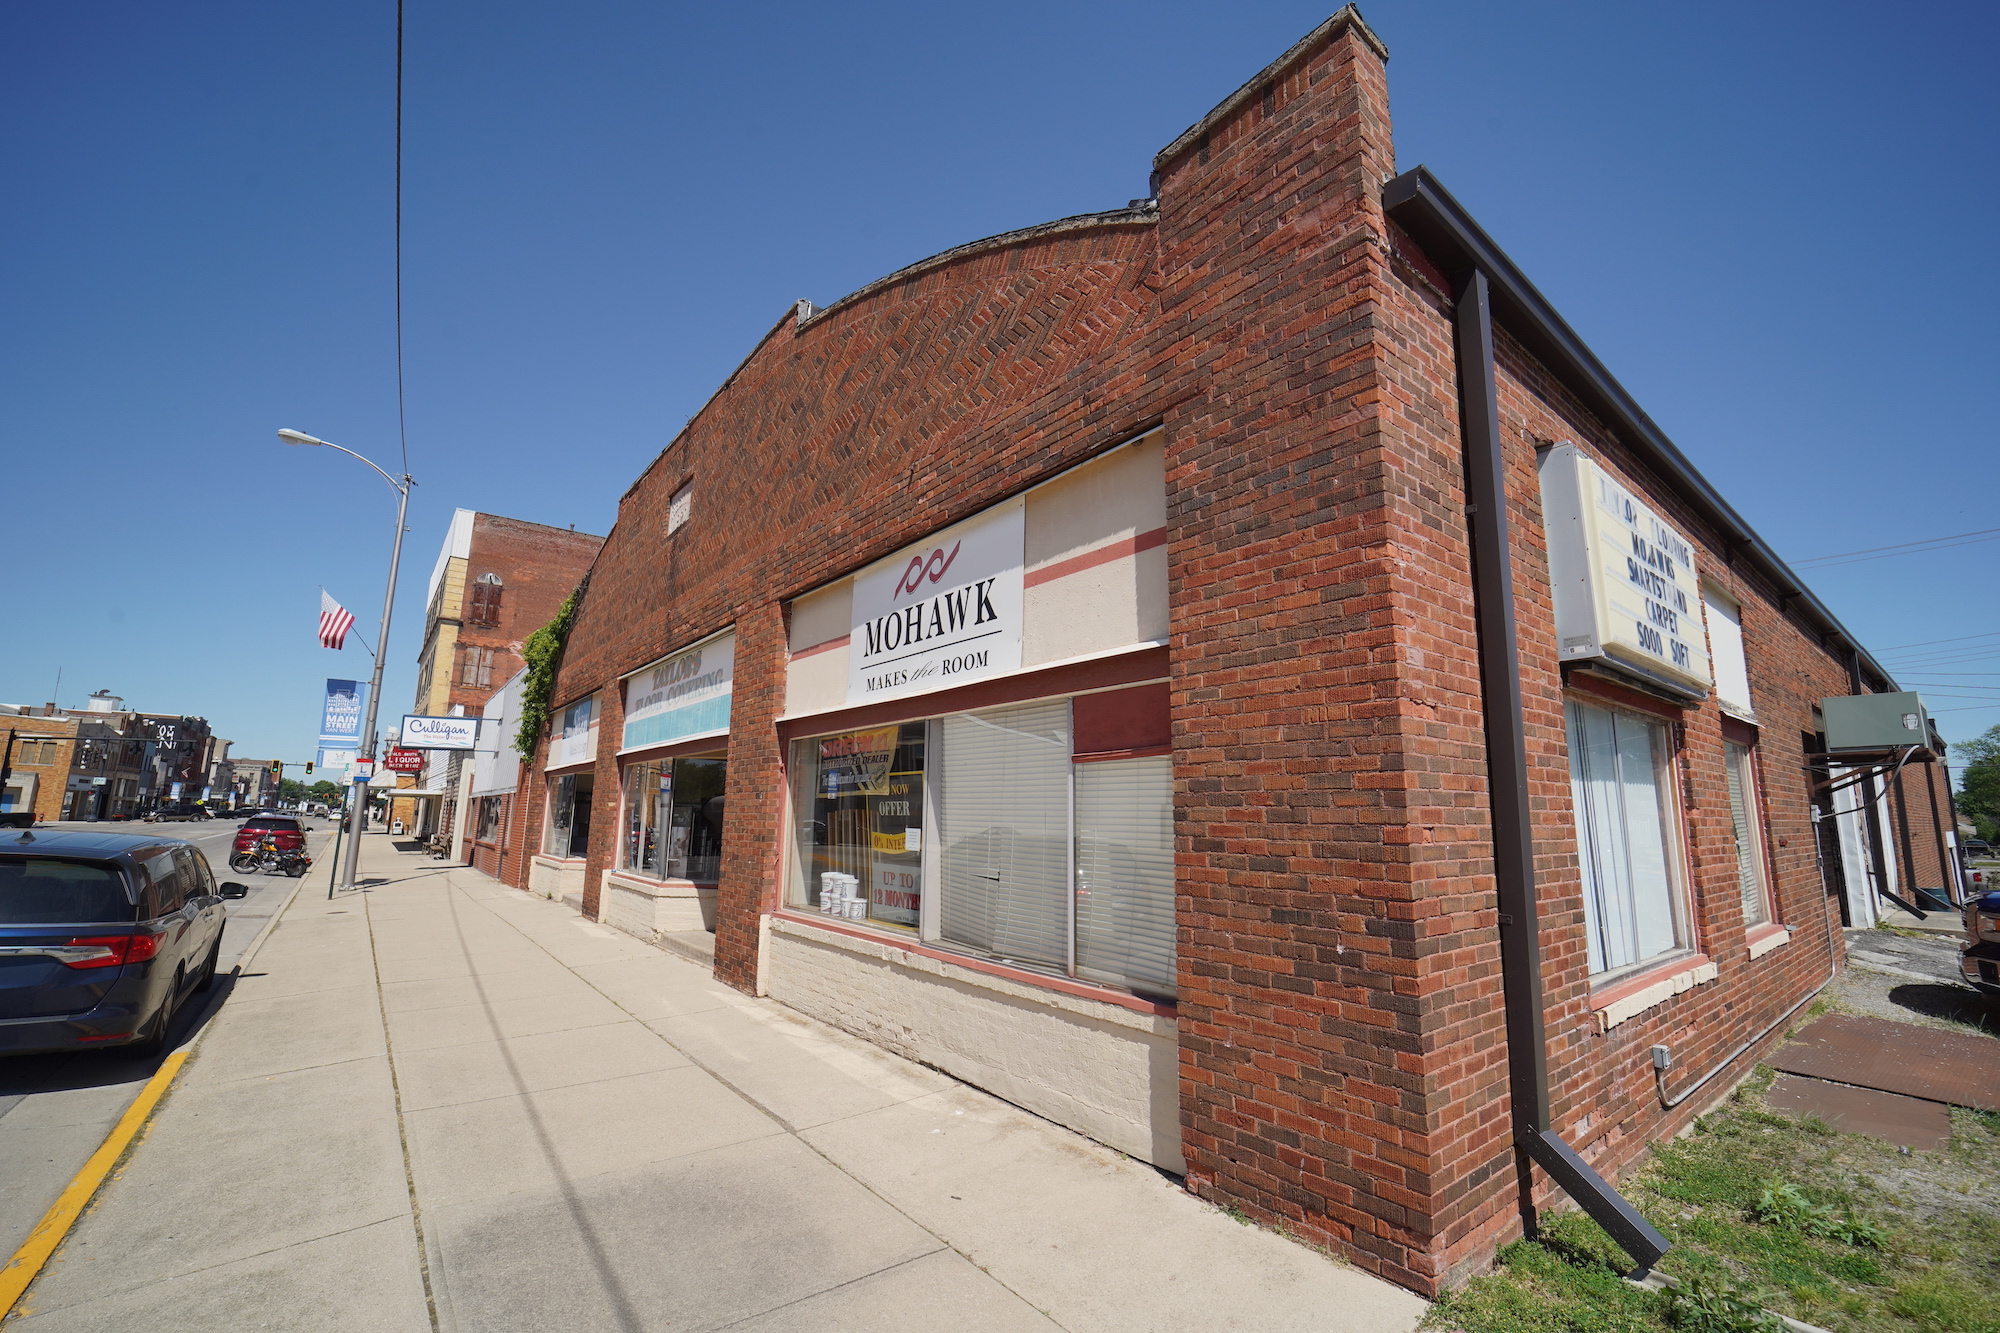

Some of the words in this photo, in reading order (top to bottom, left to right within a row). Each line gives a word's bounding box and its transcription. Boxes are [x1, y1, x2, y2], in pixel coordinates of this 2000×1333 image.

[863, 577, 998, 658] MOHAWK
[1645, 597, 1679, 635] CARPET
[1636, 620, 1663, 657] SOOO
[1670, 637, 1690, 669] SOFT
[652, 649, 702, 691] TAYLOR'S
[866, 669, 908, 692] MAKES
[910, 660, 939, 682] the
[942, 650, 990, 676] ROOM
[635, 691, 663, 717] FLOOR
[667, 668, 724, 706] COVERING
[326, 714, 358, 724] MAIN
[410, 719, 469, 740] Culligan
[823, 757, 861, 769] AUTHORIZED
[862, 754, 889, 765] DEALER
[890, 784, 909, 795] NOW
[879, 801, 910, 816] OFFER
[883, 871, 895, 886] UP
[899, 873, 914, 888] TO
[874, 889, 883, 905] 12
